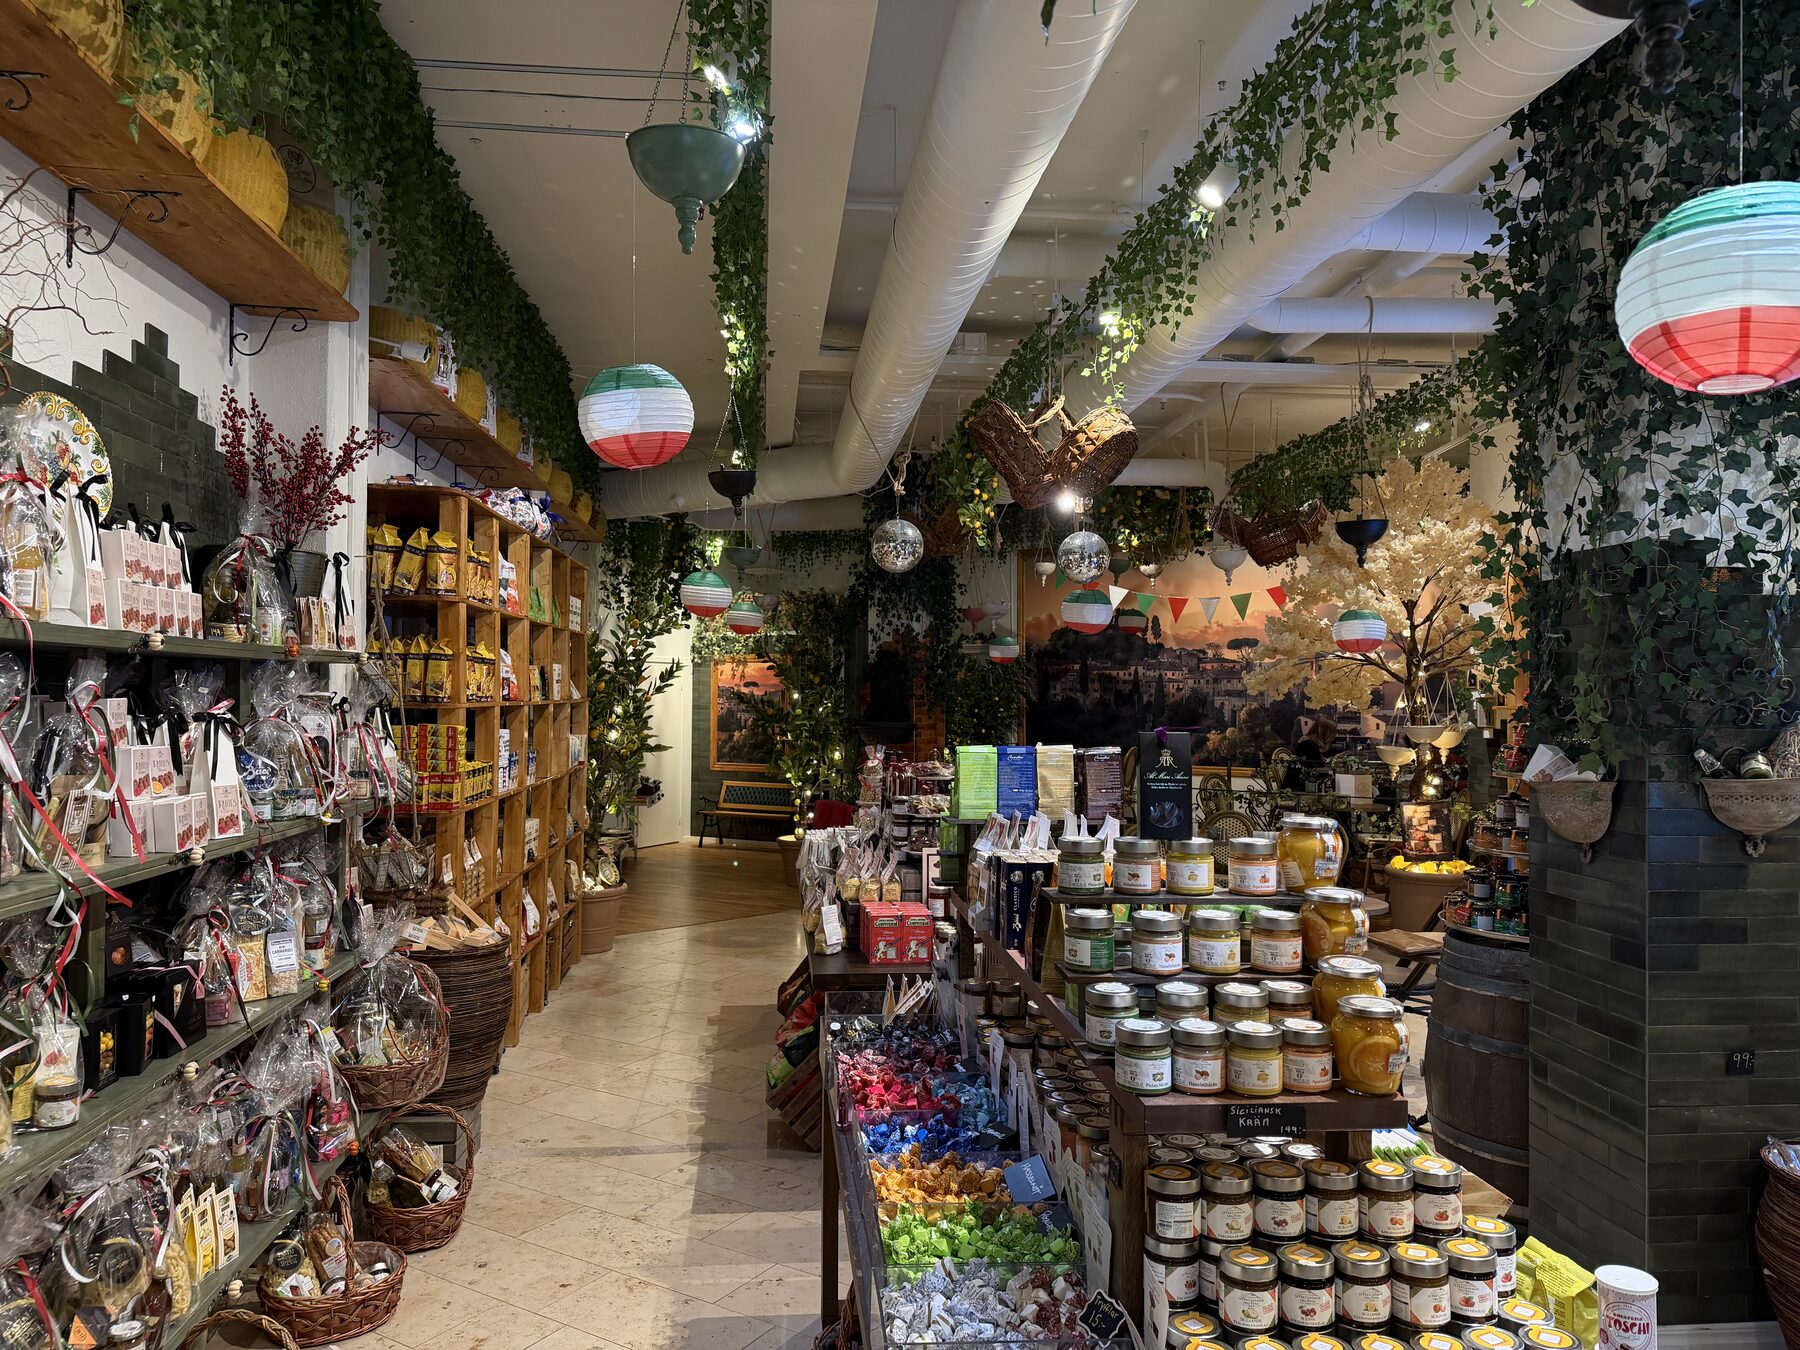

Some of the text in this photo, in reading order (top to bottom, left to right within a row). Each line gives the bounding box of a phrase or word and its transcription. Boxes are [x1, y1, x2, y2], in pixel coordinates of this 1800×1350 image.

[1239, 1116, 1270, 1128] KRÄM
[1613, 1312, 1643, 1322] amarena
[1606, 1315, 1650, 1336] TOSCHI
